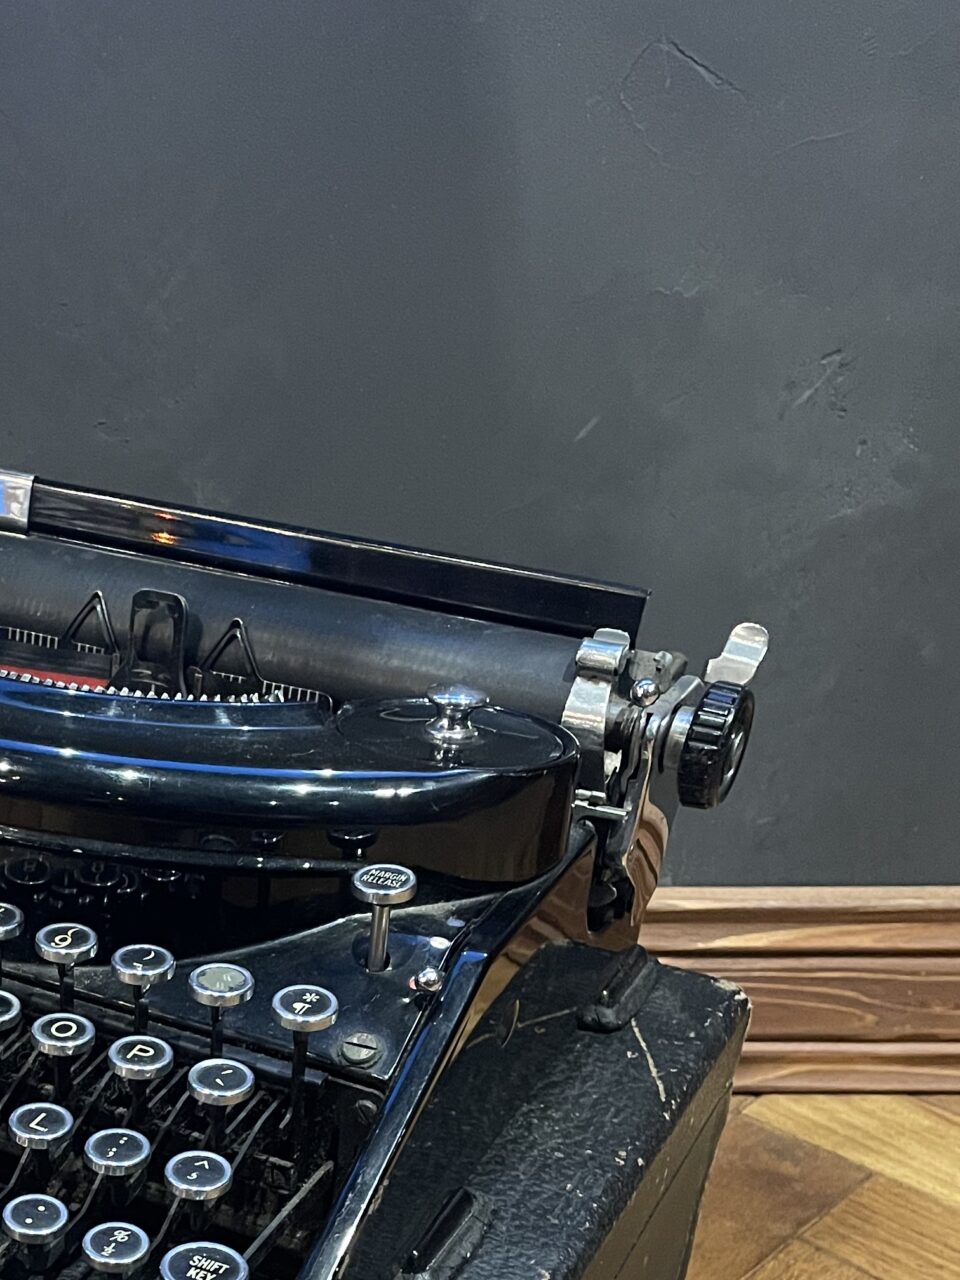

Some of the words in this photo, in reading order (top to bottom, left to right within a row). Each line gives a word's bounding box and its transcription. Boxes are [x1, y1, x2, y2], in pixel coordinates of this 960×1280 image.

[361, 875, 403, 888] RELEASE
[368, 869, 408, 882] MARGIN
[50, 934, 72, 948] 9
[51, 1021, 77, 1037] O
[127, 1045, 154, 1058] P
[28, 1112, 48, 1133] L
[189, 1255, 230, 1275] SHIFT
